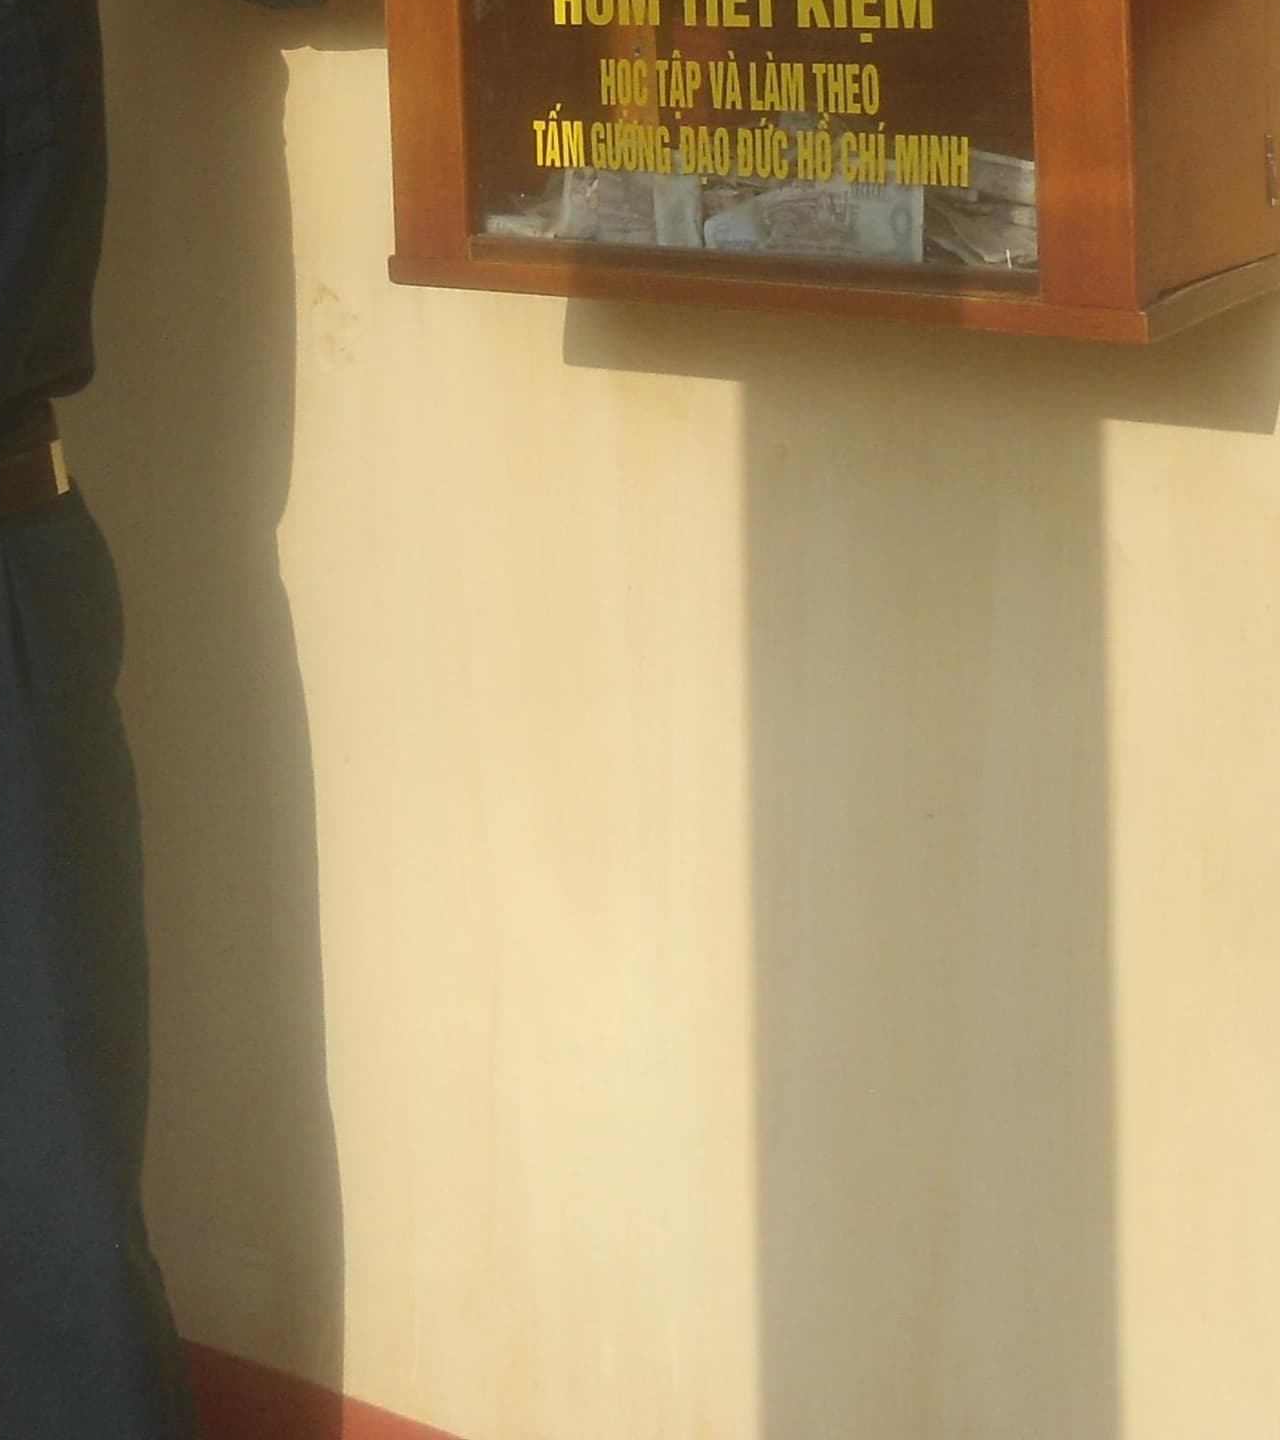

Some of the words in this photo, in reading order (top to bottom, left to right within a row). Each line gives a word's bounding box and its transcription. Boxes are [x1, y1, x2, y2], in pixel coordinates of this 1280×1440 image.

[600, 58, 649, 117] HỌC
[656, 50, 702, 120] TẬP
[709, 50, 743, 111] VÀ
[749, 50, 806, 112] LÀM
[811, 62, 881, 116] THEO
[533, 102, 586, 168] TẤM
[590, 119, 672, 175] GƯƠNG
[679, 126, 731, 185] ĐẠO
[736, 117, 790, 181] ĐỨC
[796, 113, 832, 182] HỒ
[840, 121, 887, 184] CHÍ
[894, 134, 970, 188] MINH
